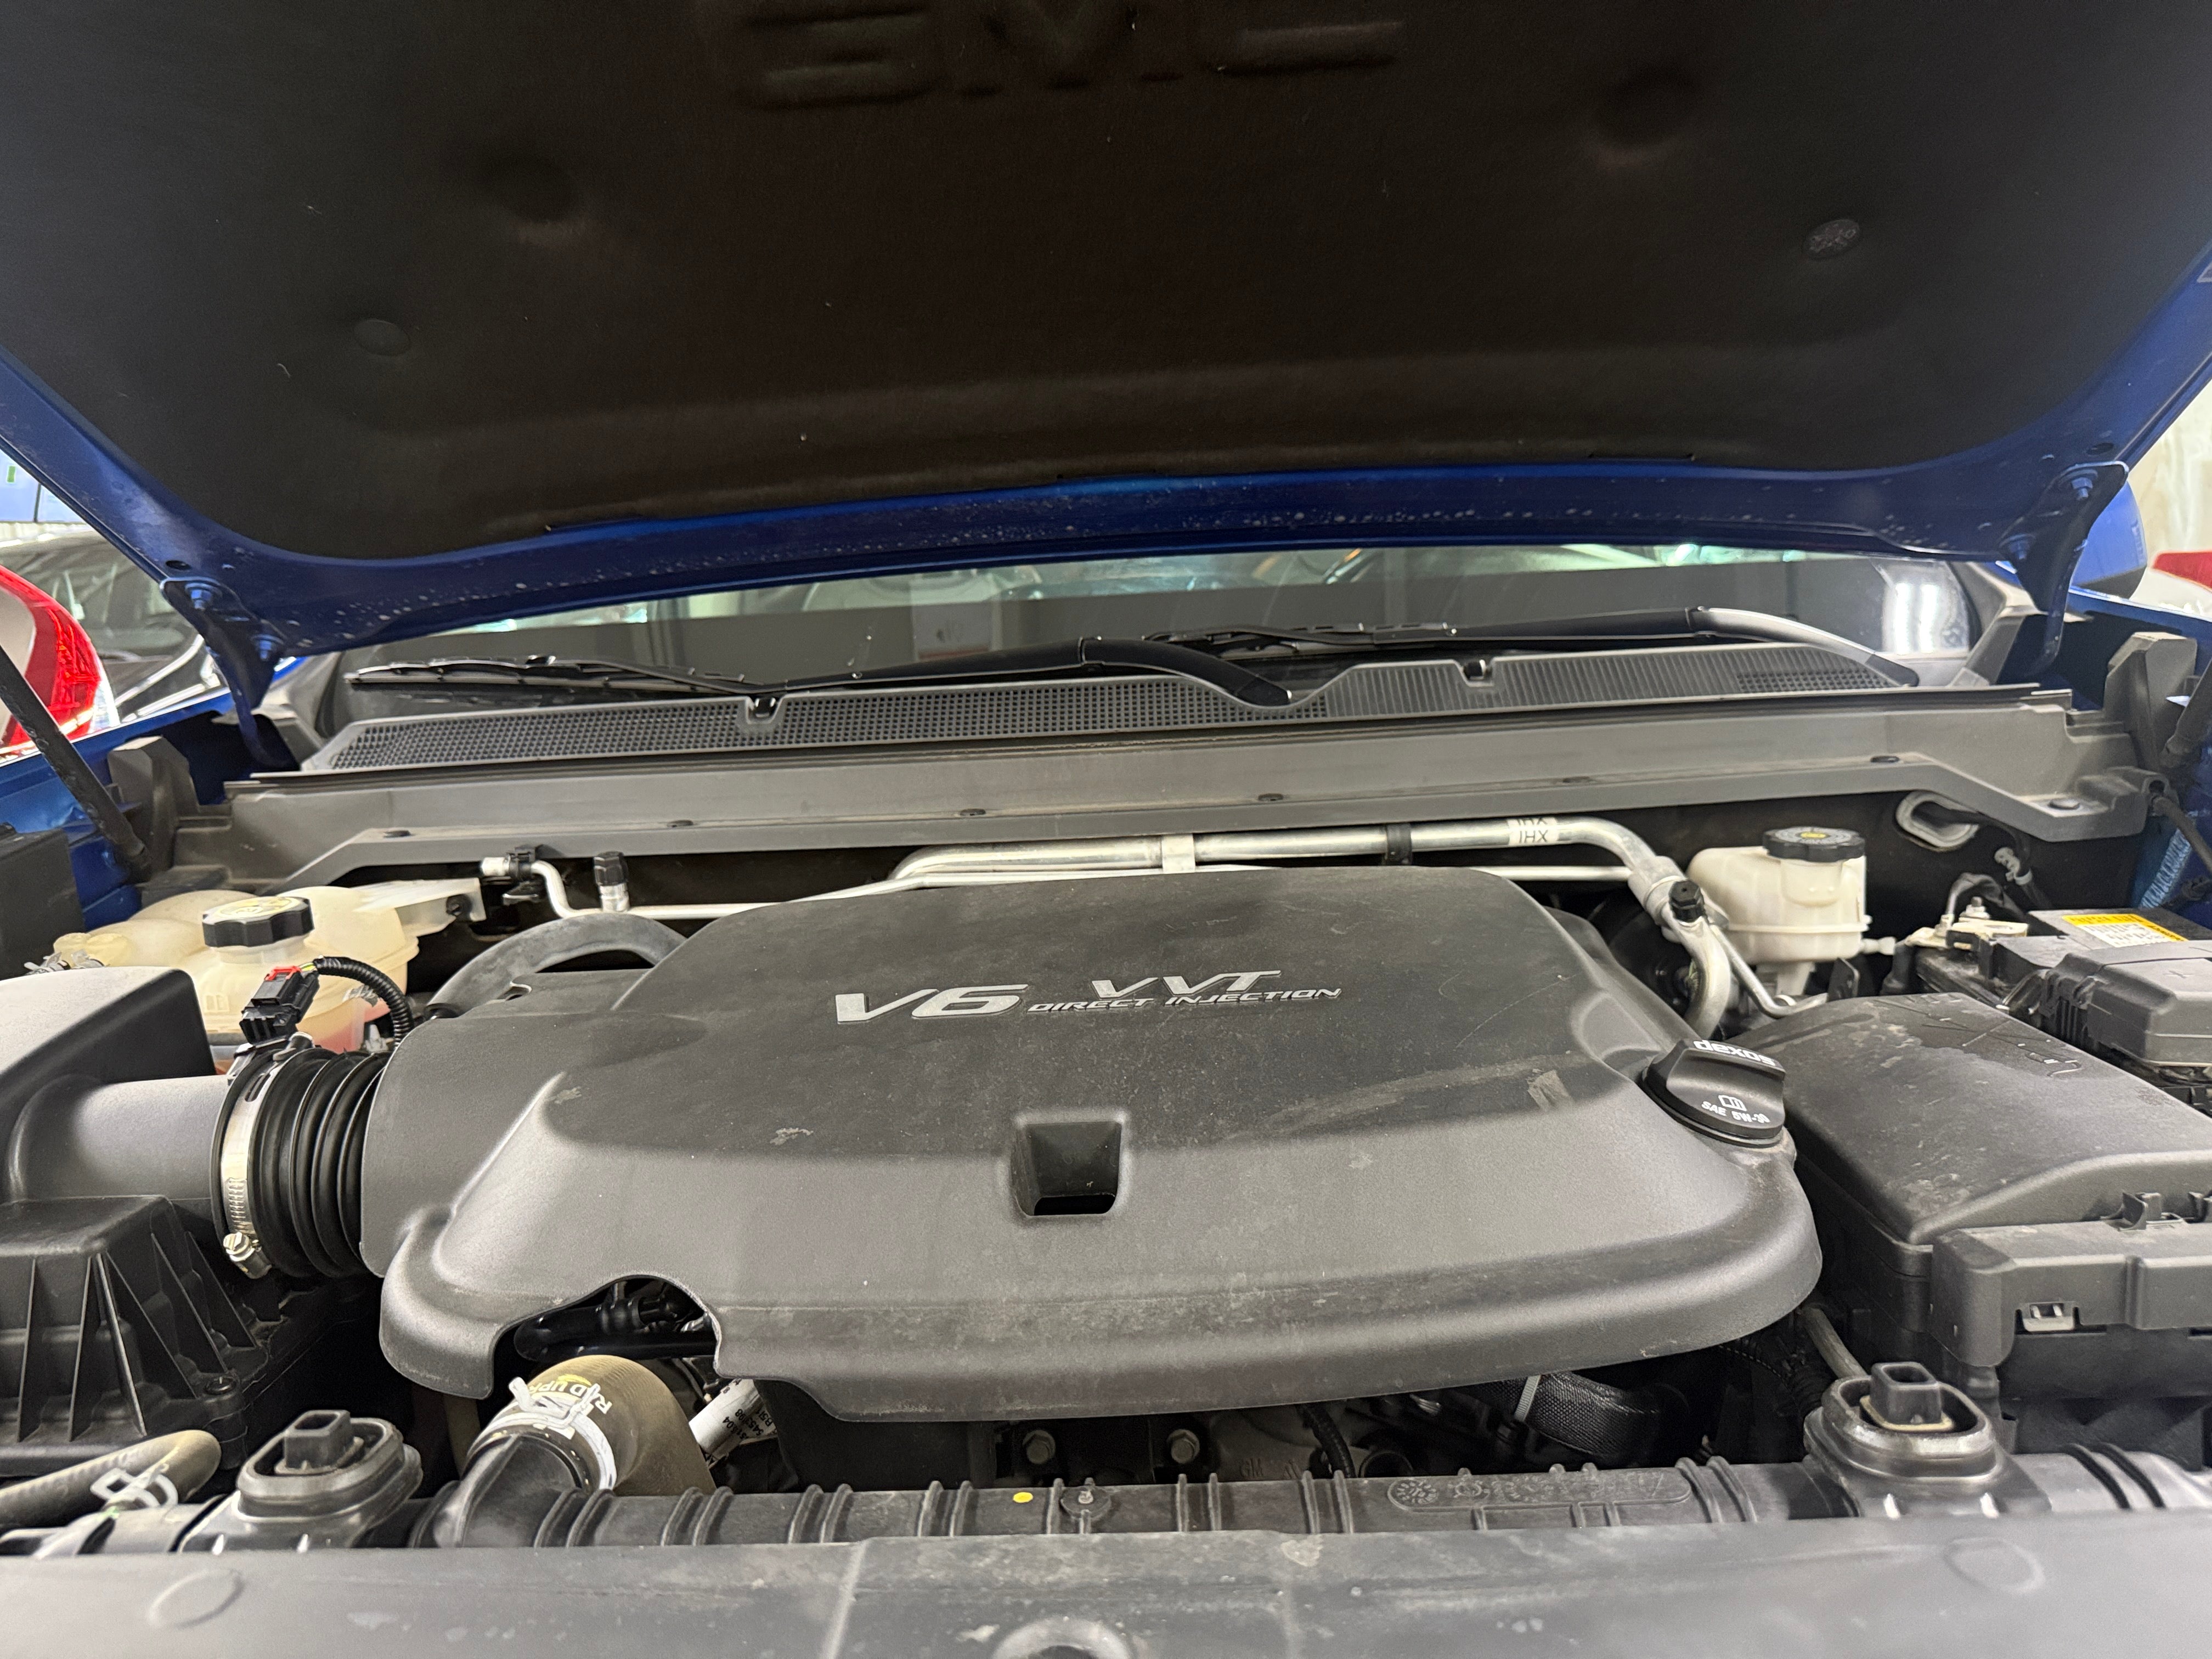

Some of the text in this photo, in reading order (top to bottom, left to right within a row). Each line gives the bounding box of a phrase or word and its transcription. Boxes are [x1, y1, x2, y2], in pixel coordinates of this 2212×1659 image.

[1519, 830, 1548, 843] IHX
[1091, 970, 1281, 998] VVT
[836, 984, 1028, 1024] V6
[1028, 989, 1342, 1012] DIRECT INJECTION
[1694, 1040, 1776, 1066] dexos
[1701, 1101, 1770, 1124] SAE 5W-30
[569, 1384, 613, 1414] RD
